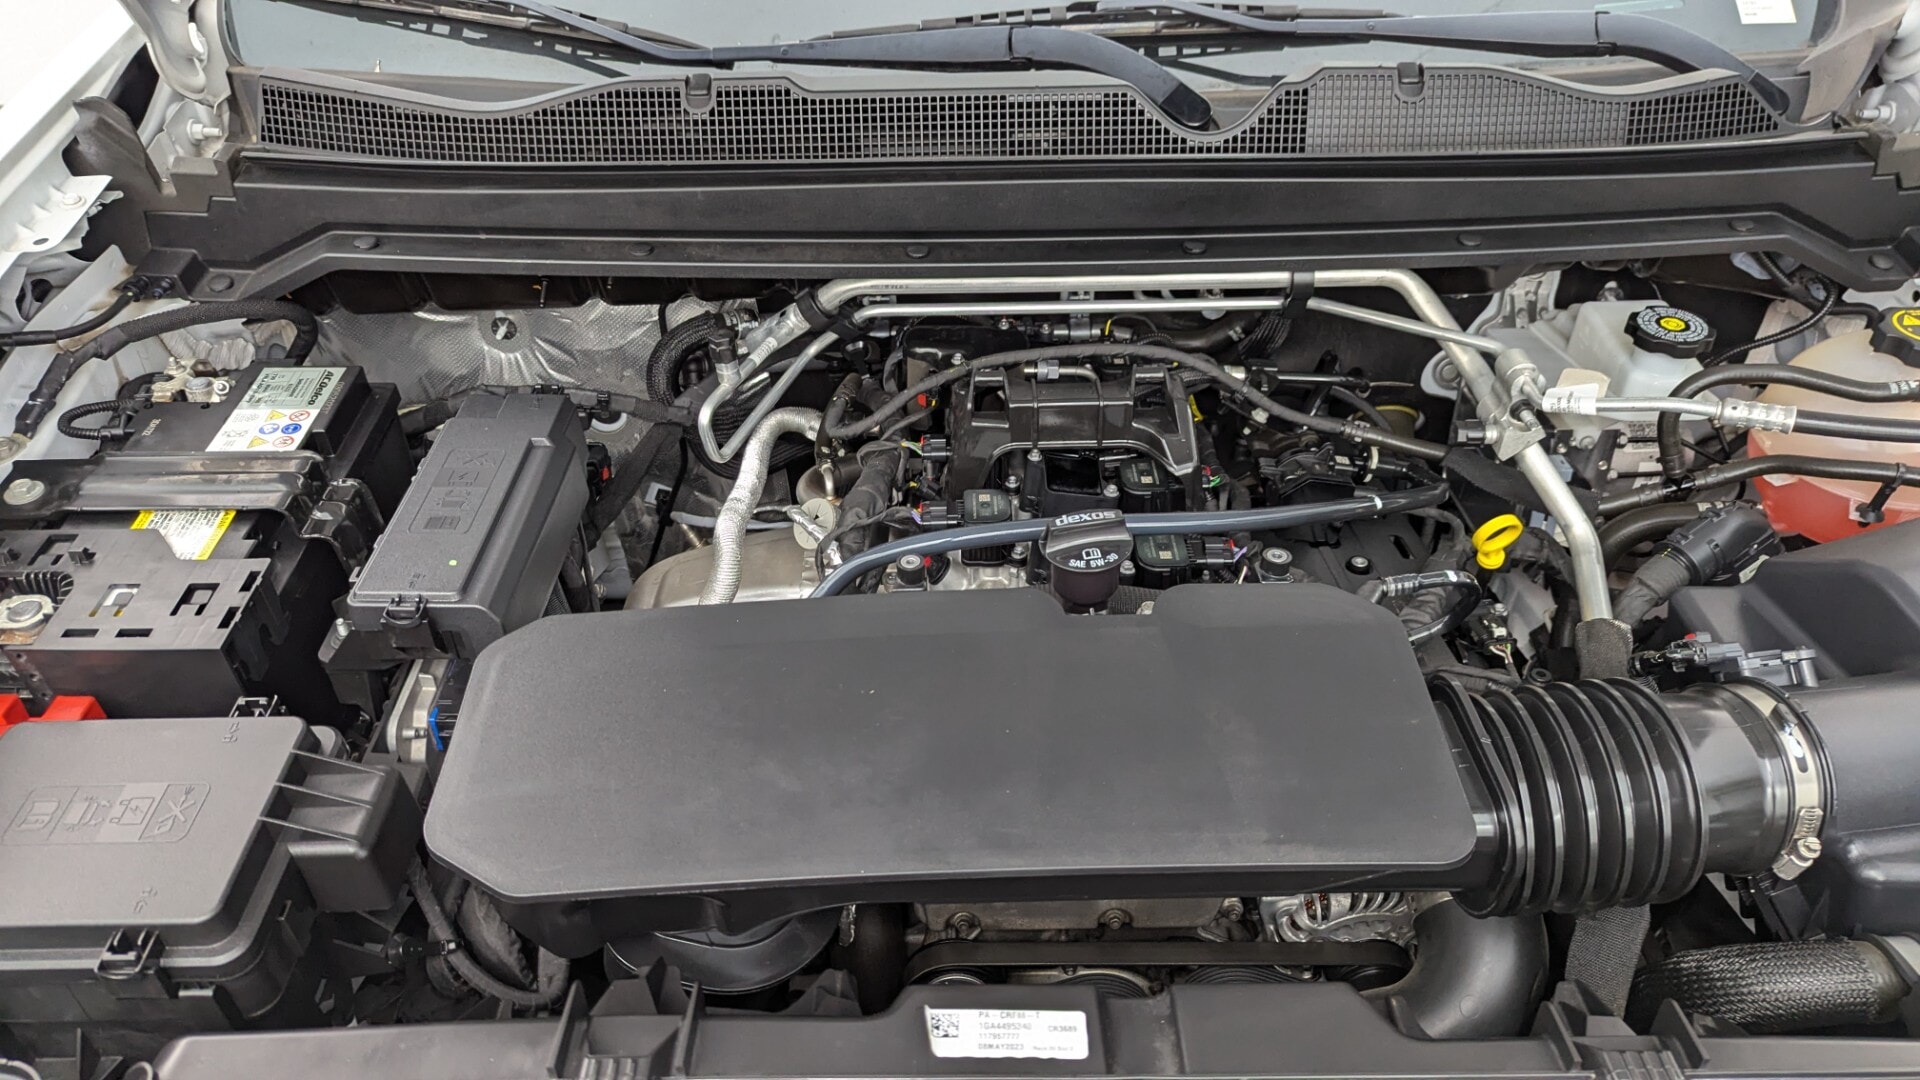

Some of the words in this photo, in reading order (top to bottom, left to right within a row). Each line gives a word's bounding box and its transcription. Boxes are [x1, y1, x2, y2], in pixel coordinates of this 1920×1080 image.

[307, 370, 334, 406] ACDelco
[1055, 511, 1116, 526] dexos
[1068, 559, 1087, 568] SAE
[1089, 552, 1119, 568] 5W-30
